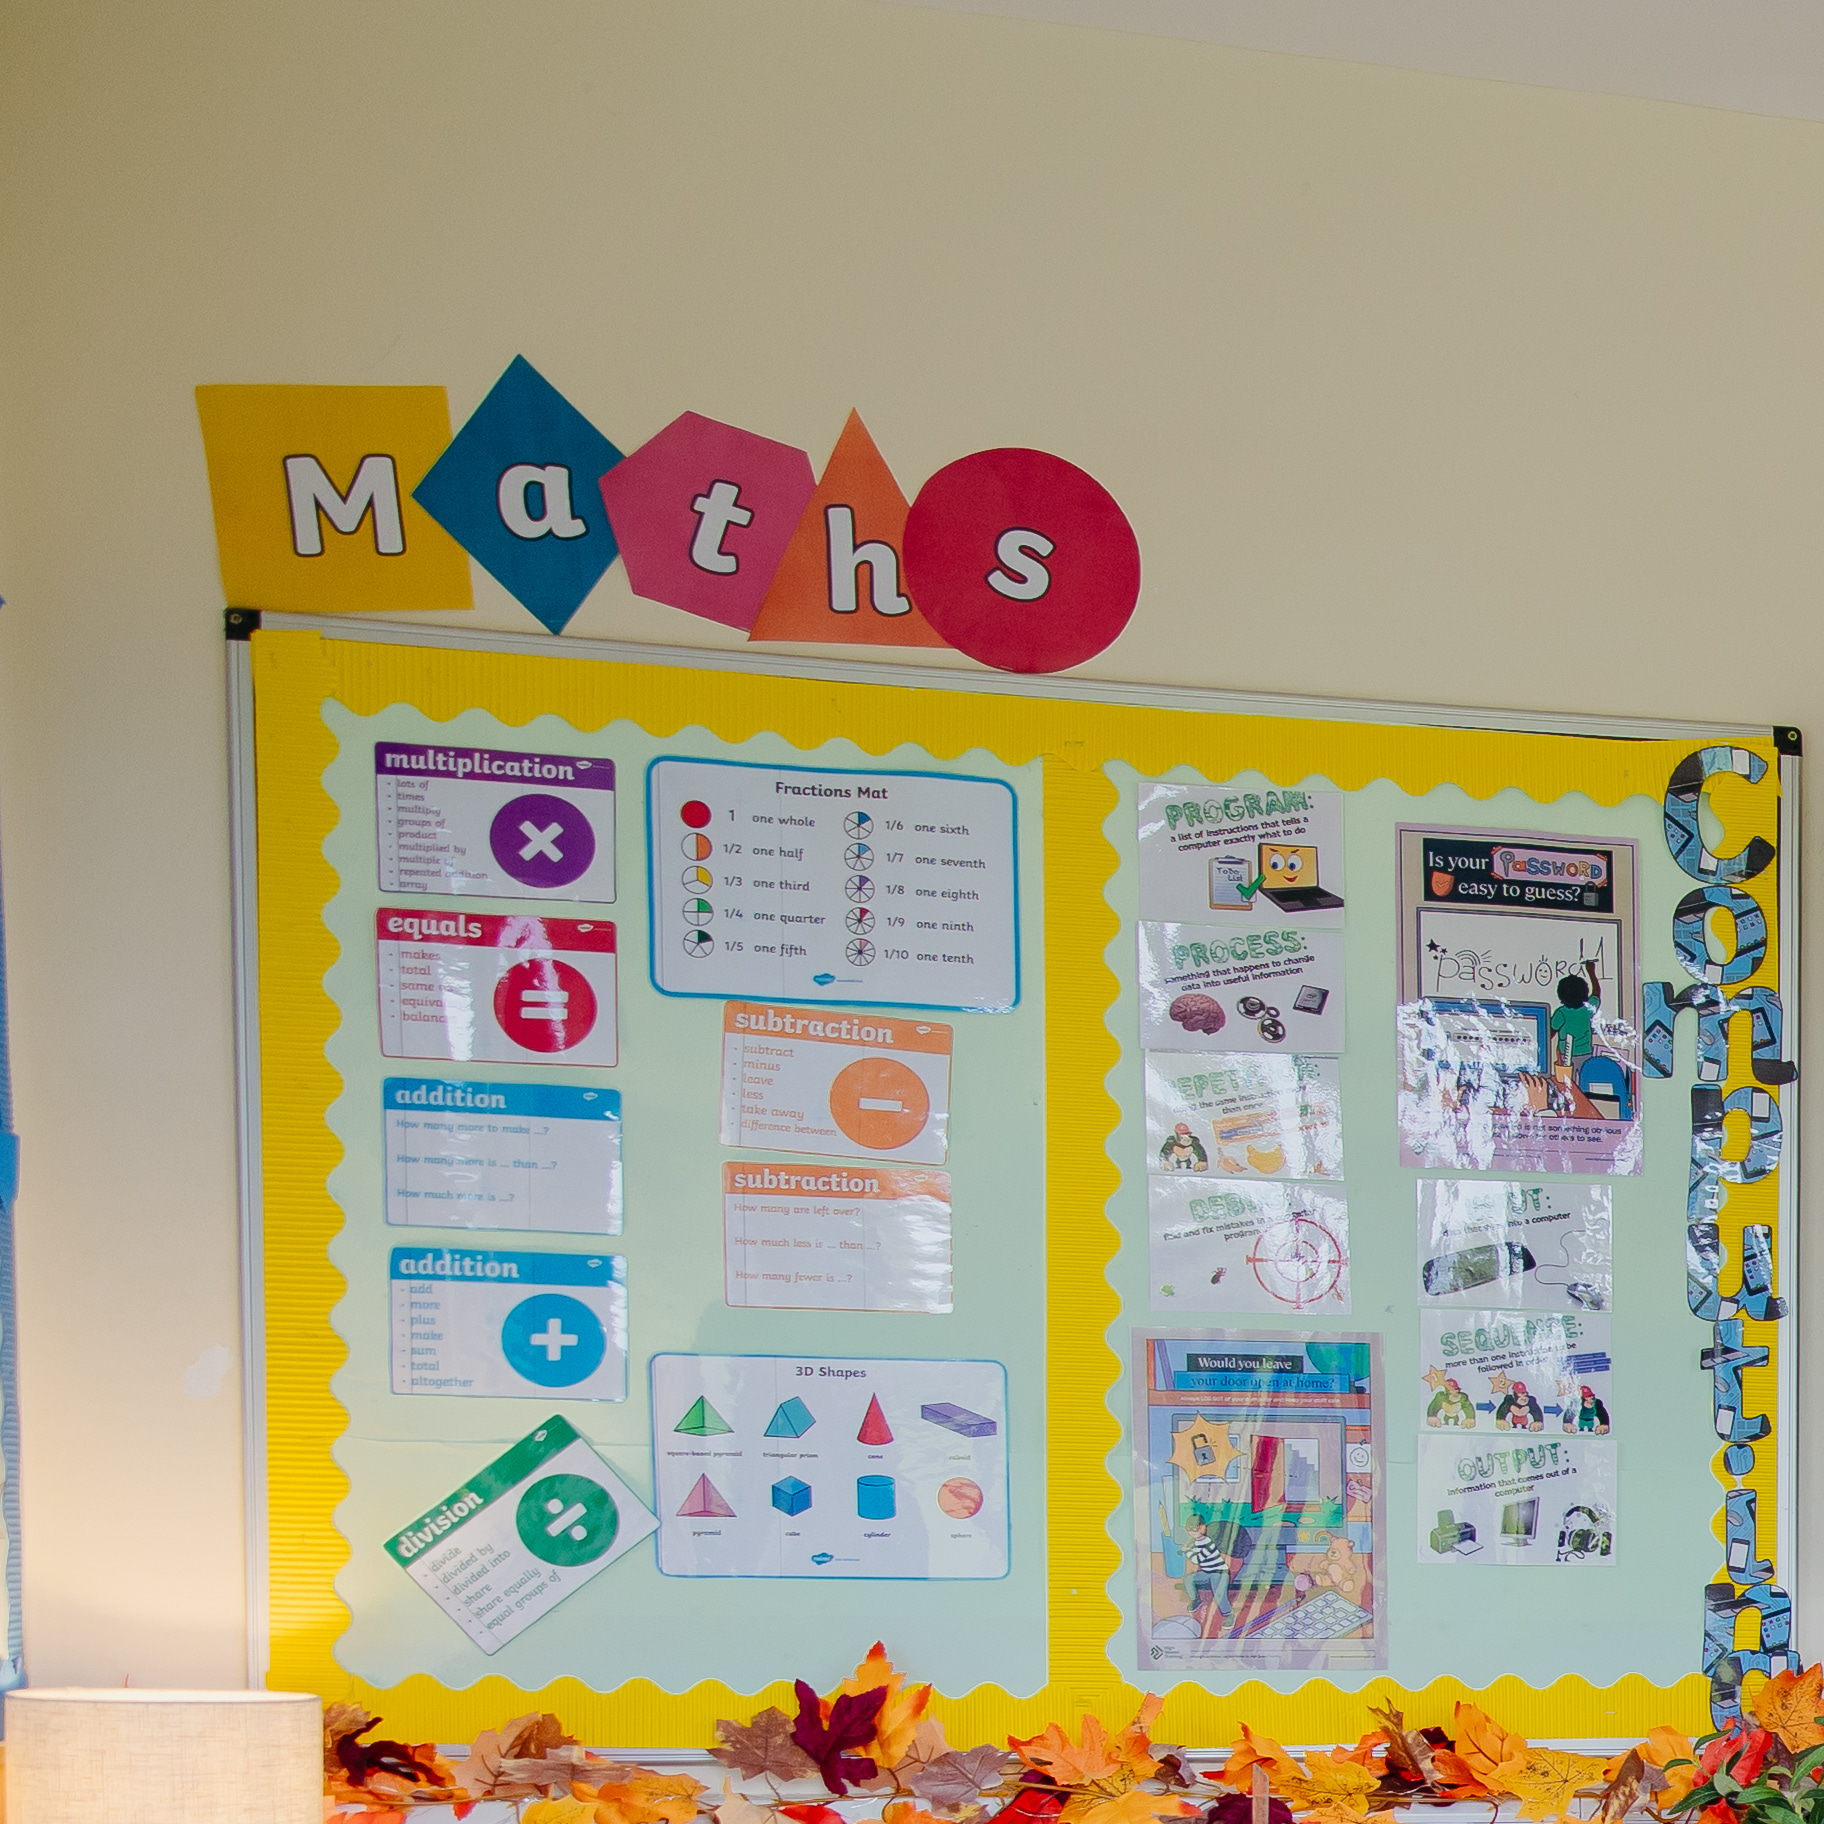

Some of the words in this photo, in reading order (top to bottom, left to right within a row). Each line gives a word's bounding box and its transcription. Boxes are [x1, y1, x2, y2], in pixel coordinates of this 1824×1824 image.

[281, 452, 1056, 618] Maths
[385, 750, 575, 780] multiplication
[775, 782, 851, 799] Fractions
[858, 786, 889, 799] Mat
[728, 810, 736, 822] 1
[752, 815, 773, 824] one
[779, 816, 815, 827] whole
[1165, 790, 1314, 830] PROGRAM:
[886, 820, 904, 831] 1/6
[915, 824, 936, 833] one
[940, 824, 970, 836] sixth
[1179, 839, 1221, 851] computer
[1224, 834, 1255, 846] exactly
[1258, 830, 1280, 840] what
[1283, 829, 1292, 837] to
[1295, 827, 1306, 835] do
[723, 843, 742, 854] 1/2
[753, 848, 774, 857] one
[779, 847, 805, 861] half
[886, 852, 904, 863] 1/7
[915, 856, 936, 865] one
[940, 857, 986, 869] seventh
[1429, 851, 1444, 868] Is
[1448, 856, 1490, 872] your
[724, 876, 743, 887] 1/3
[753, 880, 775, 890] one
[780, 879, 810, 891] third
[1458, 880, 1497, 897] easy
[1503, 880, 1520, 896] to
[1525, 886, 1581, 902] guess?
[886, 884, 905, 896] 1/8
[915, 889, 937, 898] one
[941, 889, 979, 901] eighth
[724, 908, 743, 919] 1/4
[754, 912, 775, 921] one
[780, 914, 826, 926] quarter
[886, 917, 905, 928] 1/9
[916, 921, 937, 930] one
[942, 921, 974, 932] ninth
[388, 915, 482, 940] equals
[724, 941, 744, 952] 1/5
[754, 944, 776, 954] one
[780, 943, 807, 957] fifth
[884, 949, 909, 960] 1/10
[917, 953, 938, 962] one
[942, 953, 975, 965] tenth
[1172, 930, 1307, 969] PROCESS:
[402, 966, 431, 975] total
[734, 1010, 894, 1044] subtraction
[744, 1044, 794, 1057] subtract
[743, 1059, 780, 1072] minus
[743, 1074, 773, 1086] leave
[395, 1085, 506, 1109] addition
[743, 1088, 764, 1100] less
[742, 1104, 768, 1117] take
[771, 1109, 804, 1121] away
[741, 1118, 791, 1132] difference
[794, 1122, 837, 1136] between
[734, 1169, 880, 1193] subtraction
[399, 1253, 519, 1278] addition
[410, 1283, 433, 1295] add
[411, 1314, 435, 1326] plus
[796, 1366, 813, 1378] 3D
[819, 1367, 867, 1380] Shapes
[1198, 1358, 1236, 1369] Would
[1238, 1359, 1257, 1371] you
[1262, 1358, 1292, 1369] leave
[1191, 1376, 1217, 1388] your
[1221, 1376, 1247, 1386] door
[1283, 1377, 1293, 1388] at
[1298, 1377, 1335, 1388] home?
[1458, 1442, 1569, 1481] OUTPUT:
[397, 1491, 483, 1558] division
[464, 1583, 493, 1607] share
[475, 1594, 504, 1619] share
[504, 1567, 541, 1600] equally
